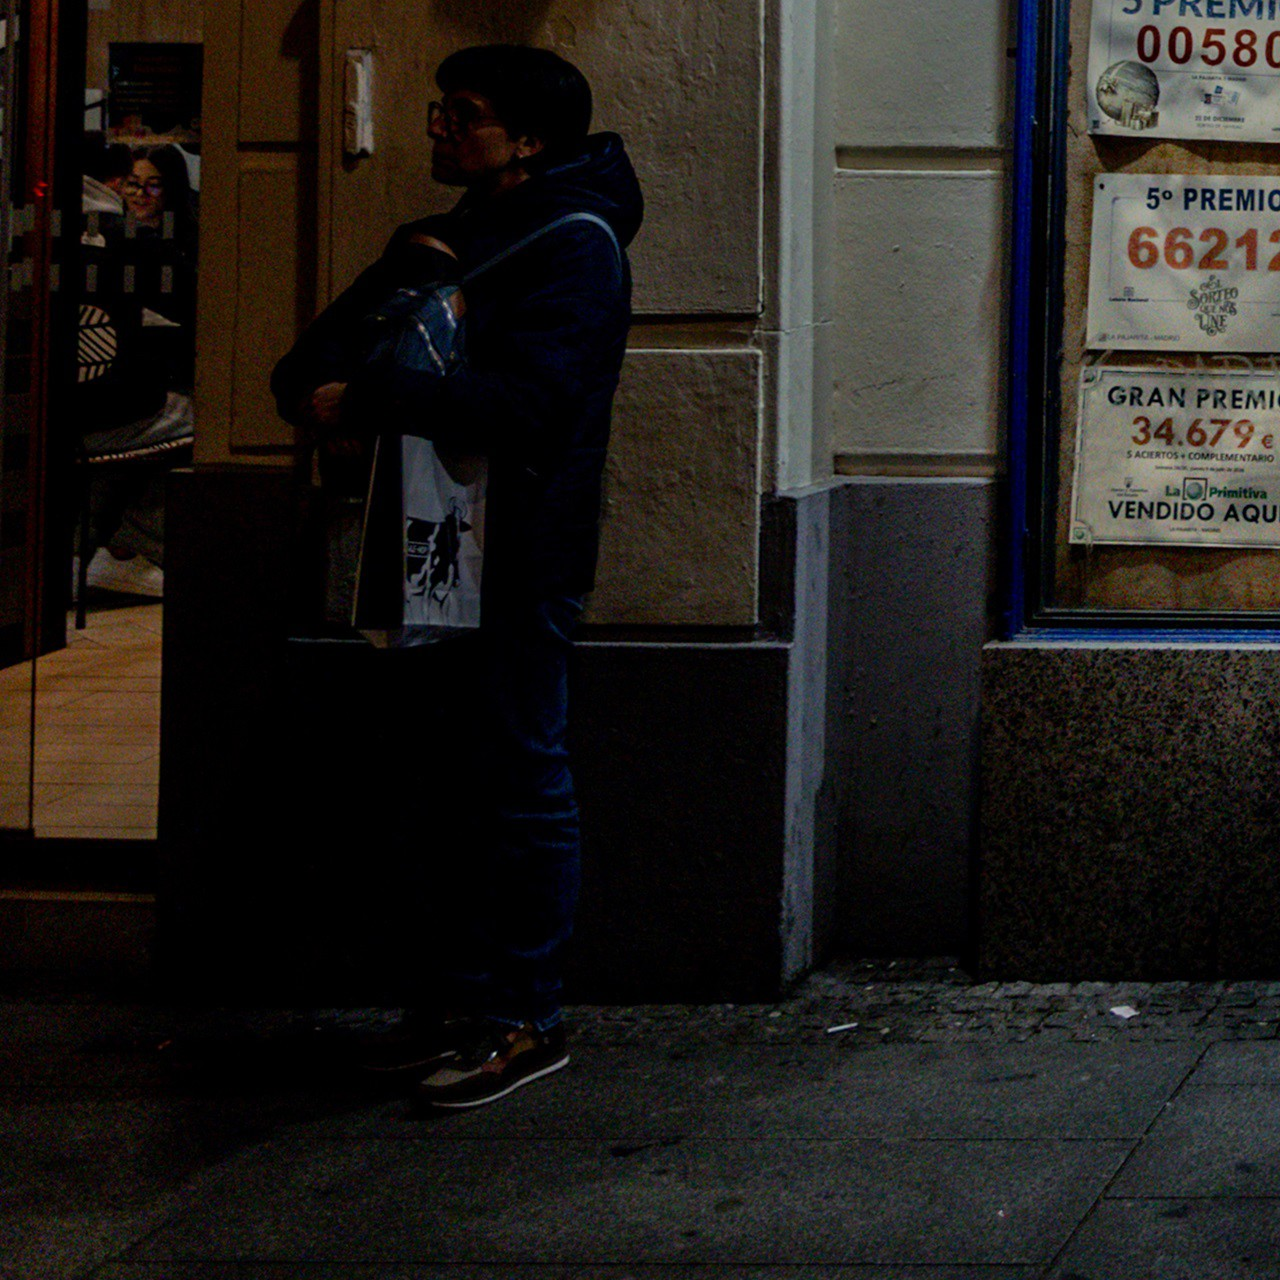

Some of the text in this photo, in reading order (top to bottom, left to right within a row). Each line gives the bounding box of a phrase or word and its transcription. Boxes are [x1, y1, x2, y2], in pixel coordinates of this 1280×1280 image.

[1146, 188, 1173, 209] 5º
[1108, 386, 1186, 408] GRAN
[1131, 415, 1274, 450] 34.679 €
[1134, 450, 1179, 460] ACIERTOS
[1188, 452, 1275, 463] COMPLEMENTARIO
[1209, 486, 1268, 500] Primitiva
[1108, 500, 1215, 521] VENDIDO
